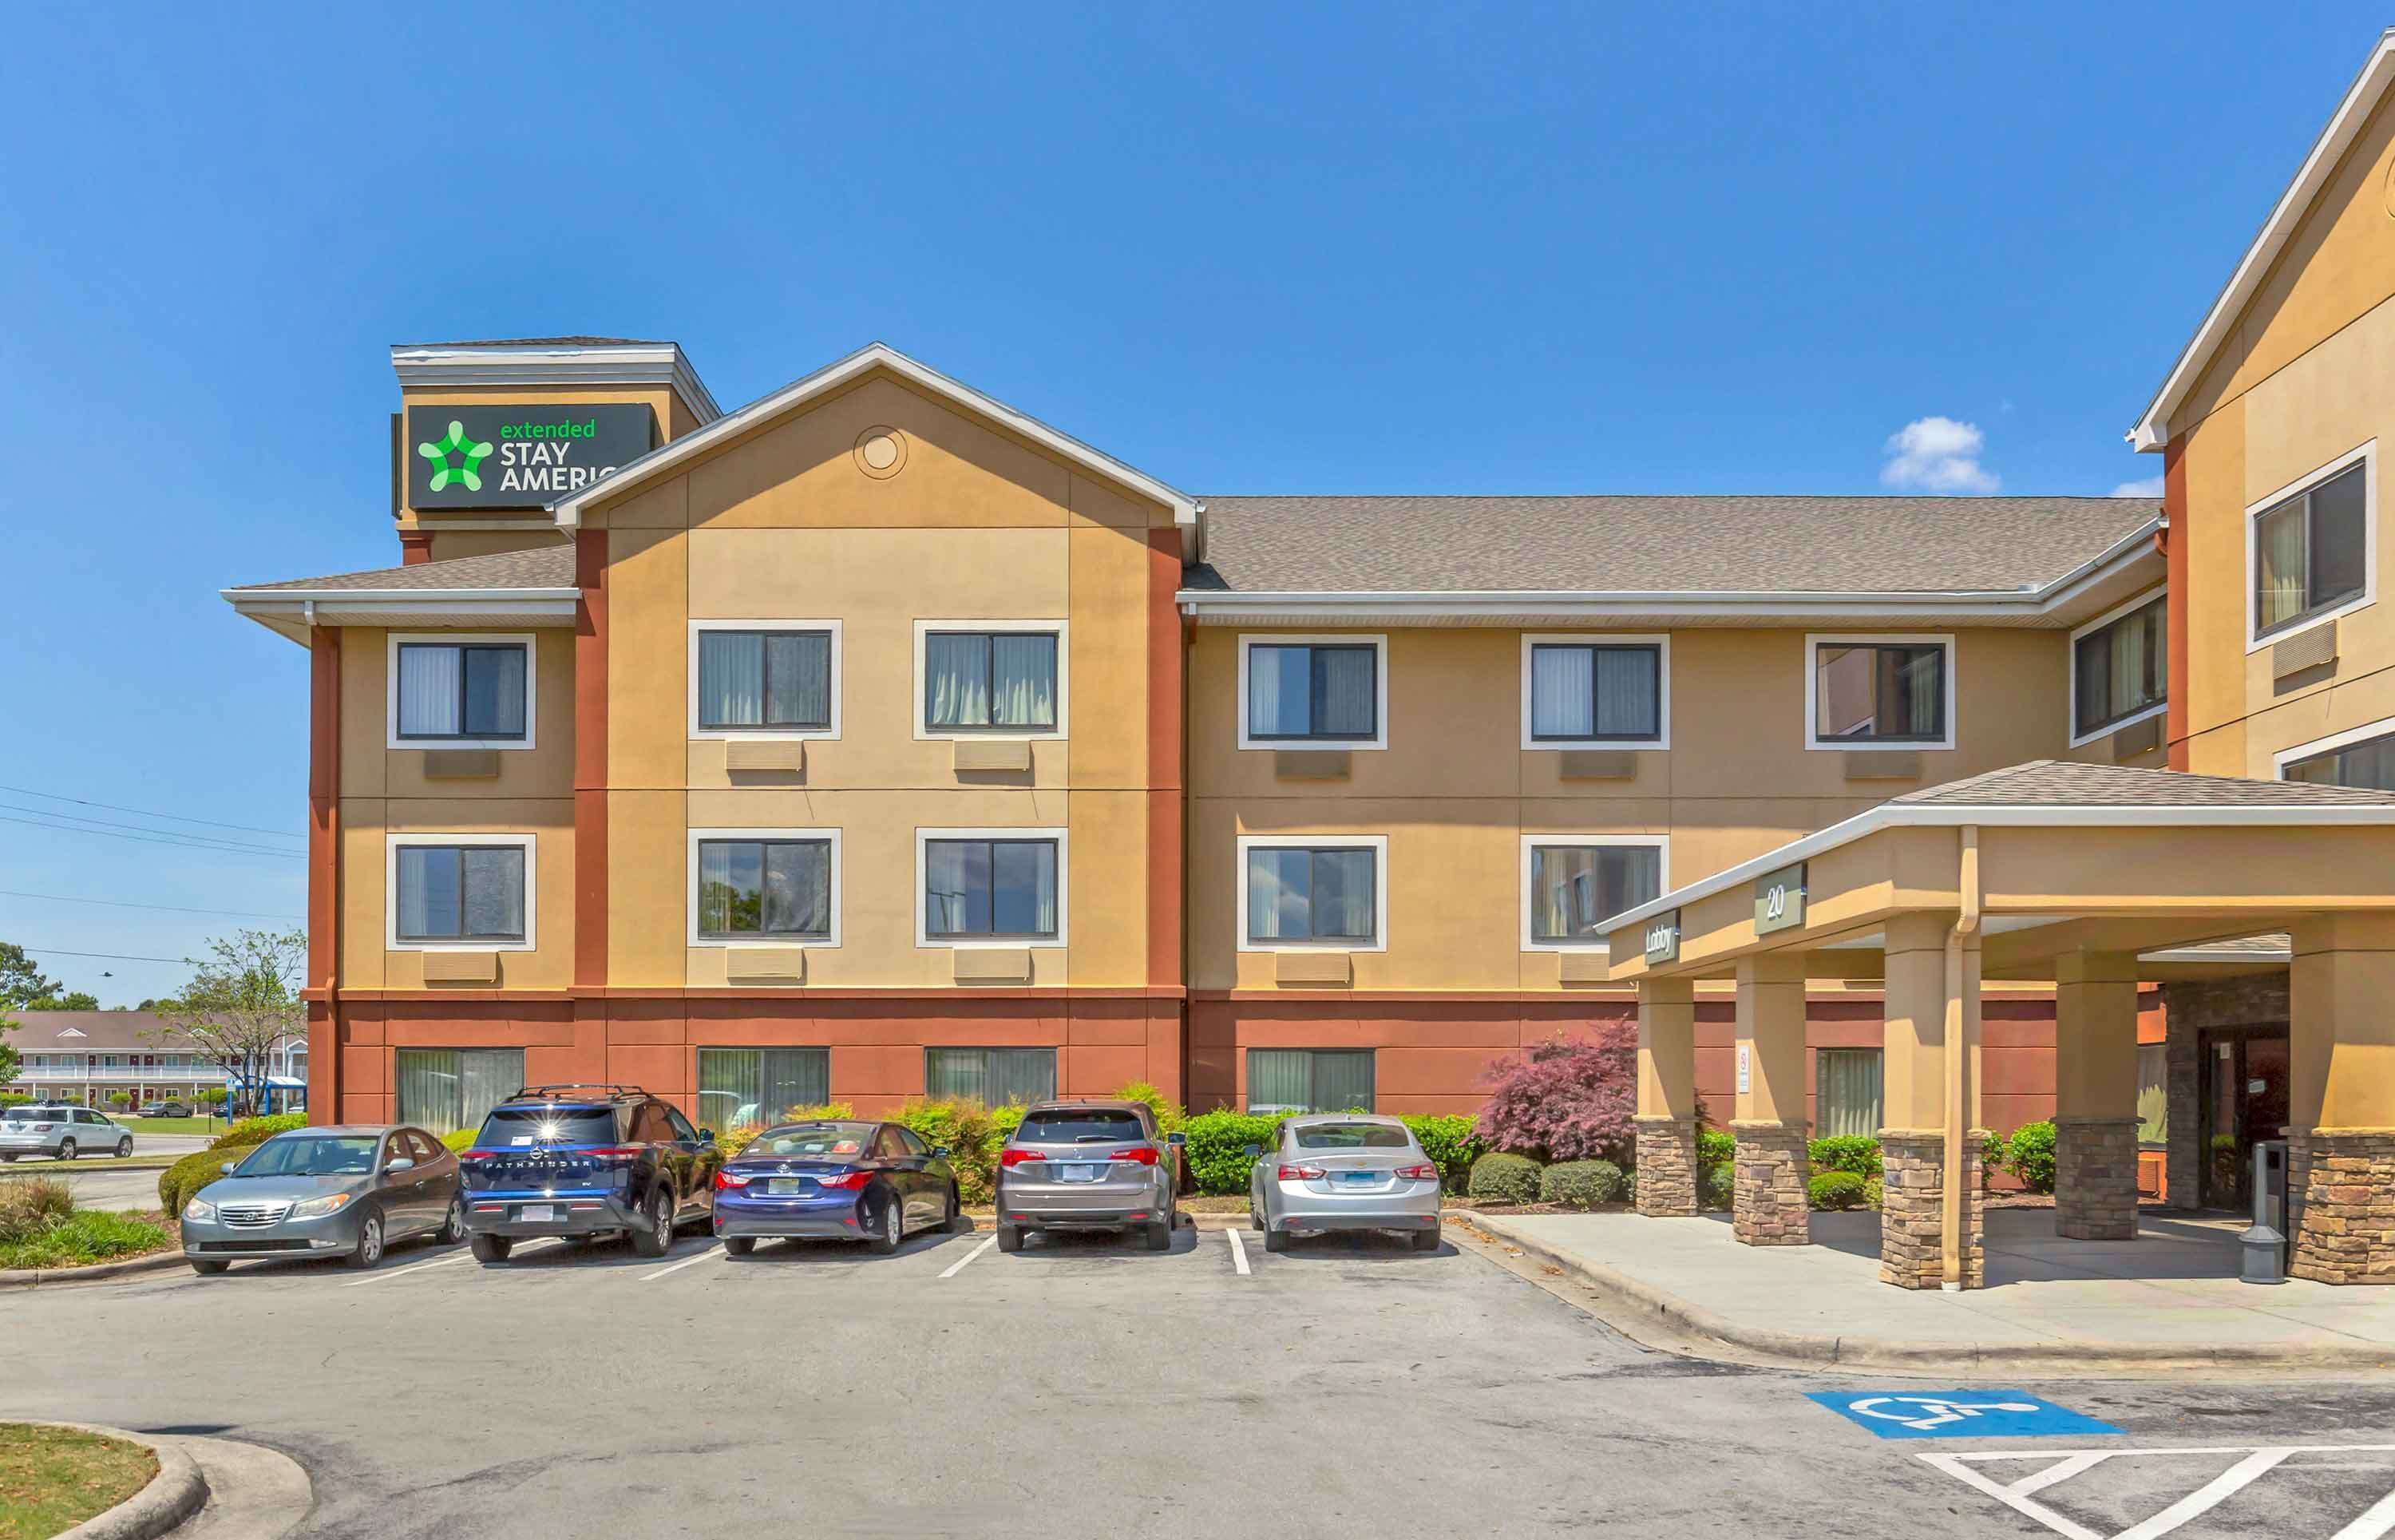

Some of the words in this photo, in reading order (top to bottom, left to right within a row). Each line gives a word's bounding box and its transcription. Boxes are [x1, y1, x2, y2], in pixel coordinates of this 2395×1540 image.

[501, 419, 595, 438] extended
[500, 442, 570, 465] STAY
[1768, 885, 1784, 918] 20
[1646, 924, 1672, 952] Lobby
